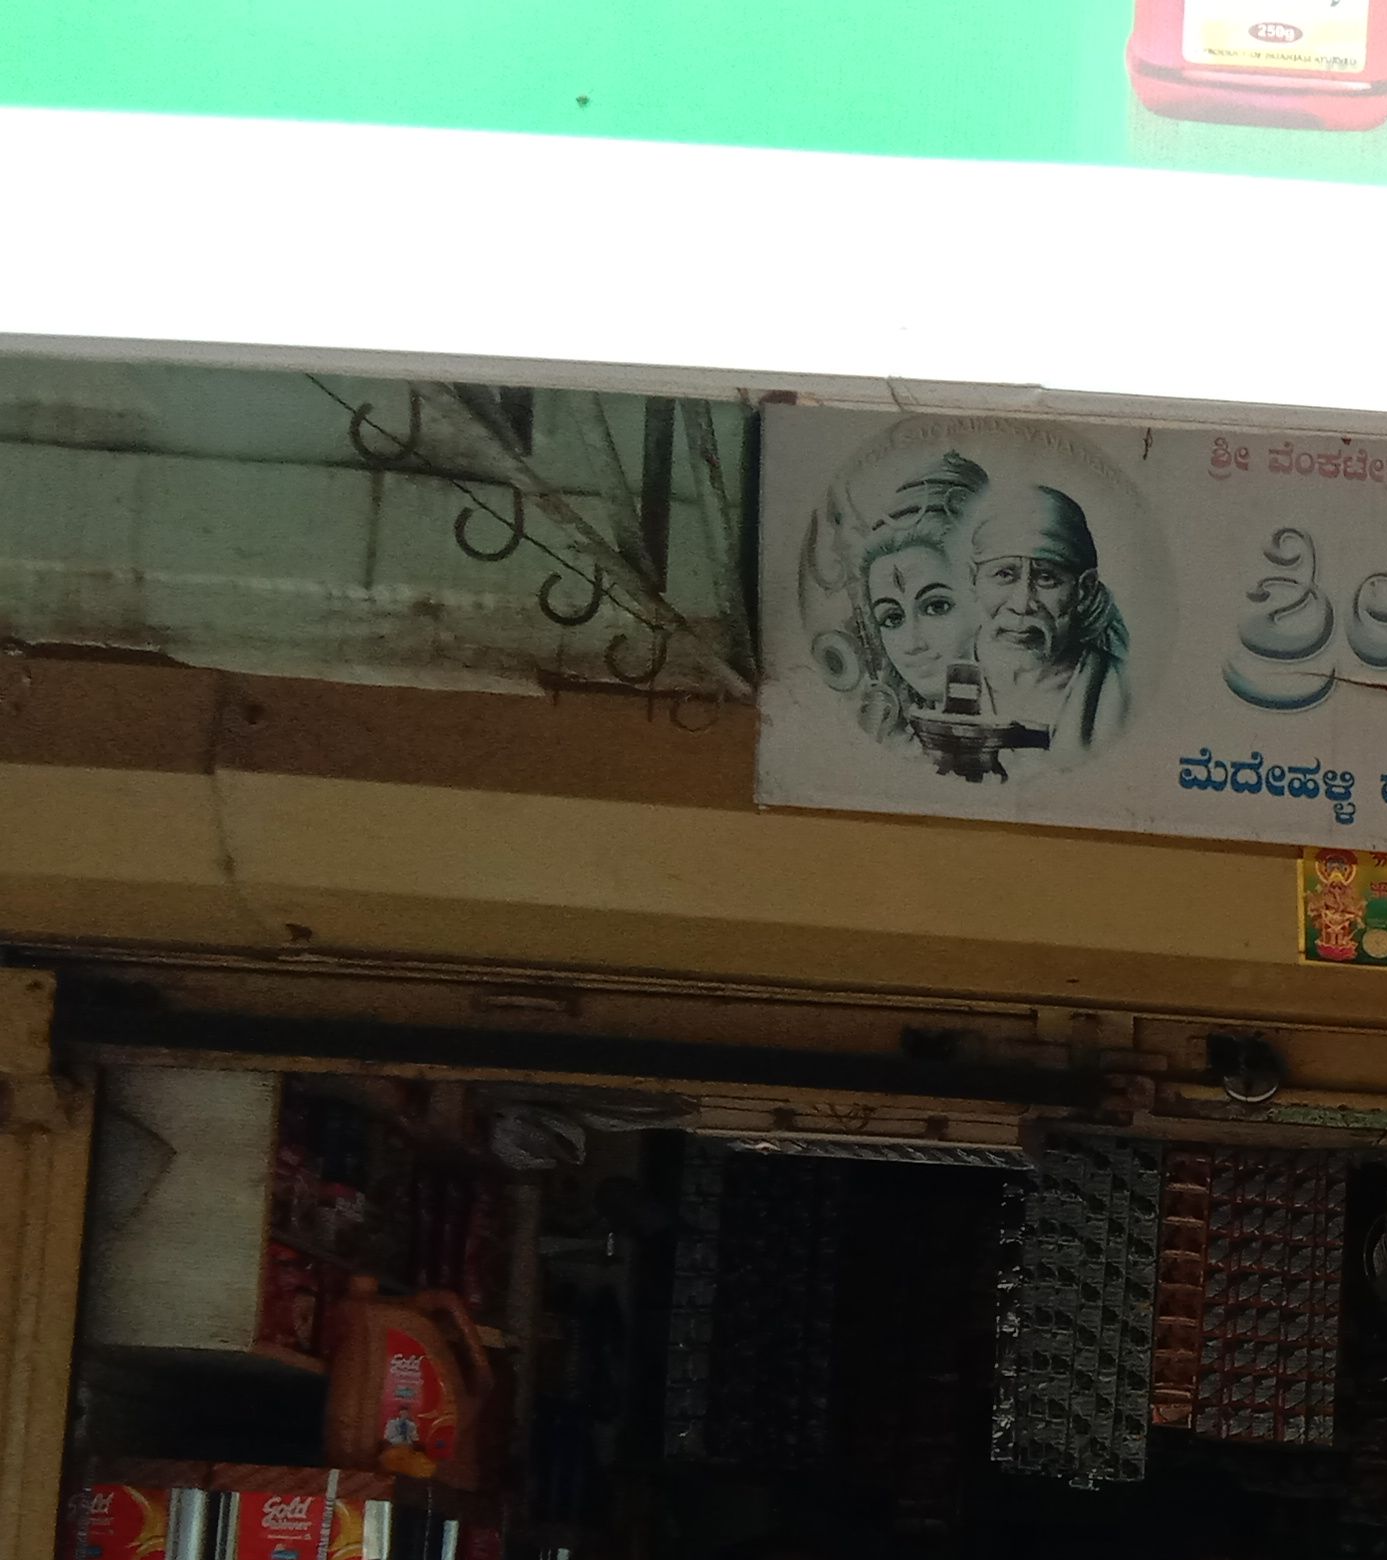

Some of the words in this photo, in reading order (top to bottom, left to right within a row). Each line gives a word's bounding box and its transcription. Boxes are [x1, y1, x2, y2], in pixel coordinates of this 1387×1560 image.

[1256, 22, 1296, 41] 250g
[1208, 435, 1251, 481] ಶ್ರೀ
[1178, 746, 1358, 826] ಮೆದೇಹಳ್ಳಿ
[262, 1495, 314, 1519] Gold
